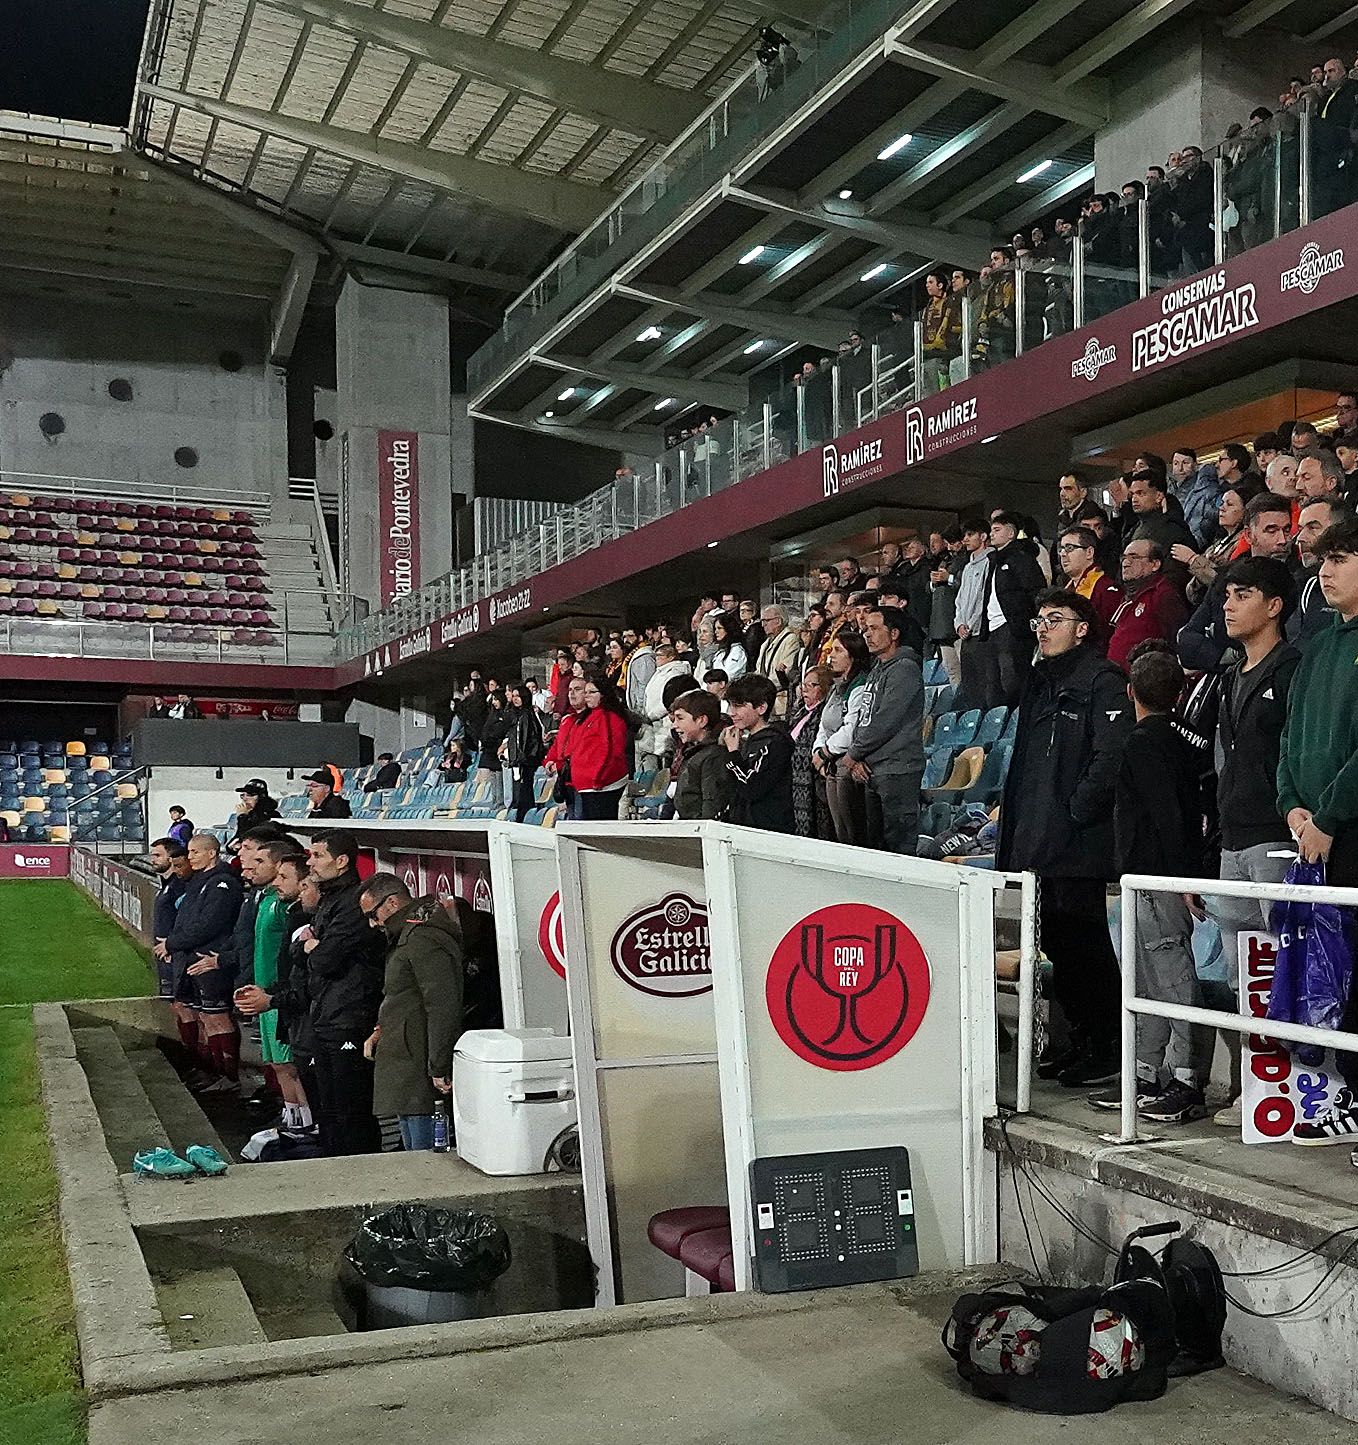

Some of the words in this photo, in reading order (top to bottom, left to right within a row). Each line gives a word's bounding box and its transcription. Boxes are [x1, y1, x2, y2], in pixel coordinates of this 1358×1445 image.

[1280, 248, 1345, 292] PESCAMAR
[1161, 269, 1226, 315] CONSERVAS
[1131, 283, 1259, 372] PESCAMAR
[1071, 344, 1117, 378] PESCAMAR
[928, 397, 978, 438] RAMÍREZ
[928, 424, 977, 452] CONSTRUCCIONES
[841, 438, 883, 474] RAMÍREZ
[940, 835, 961, 855] NEW
[25, 857, 51, 866] ence
[634, 926, 711, 950] Estrell
[834, 946, 864, 967] COPA
[839, 971, 859, 987] REY
